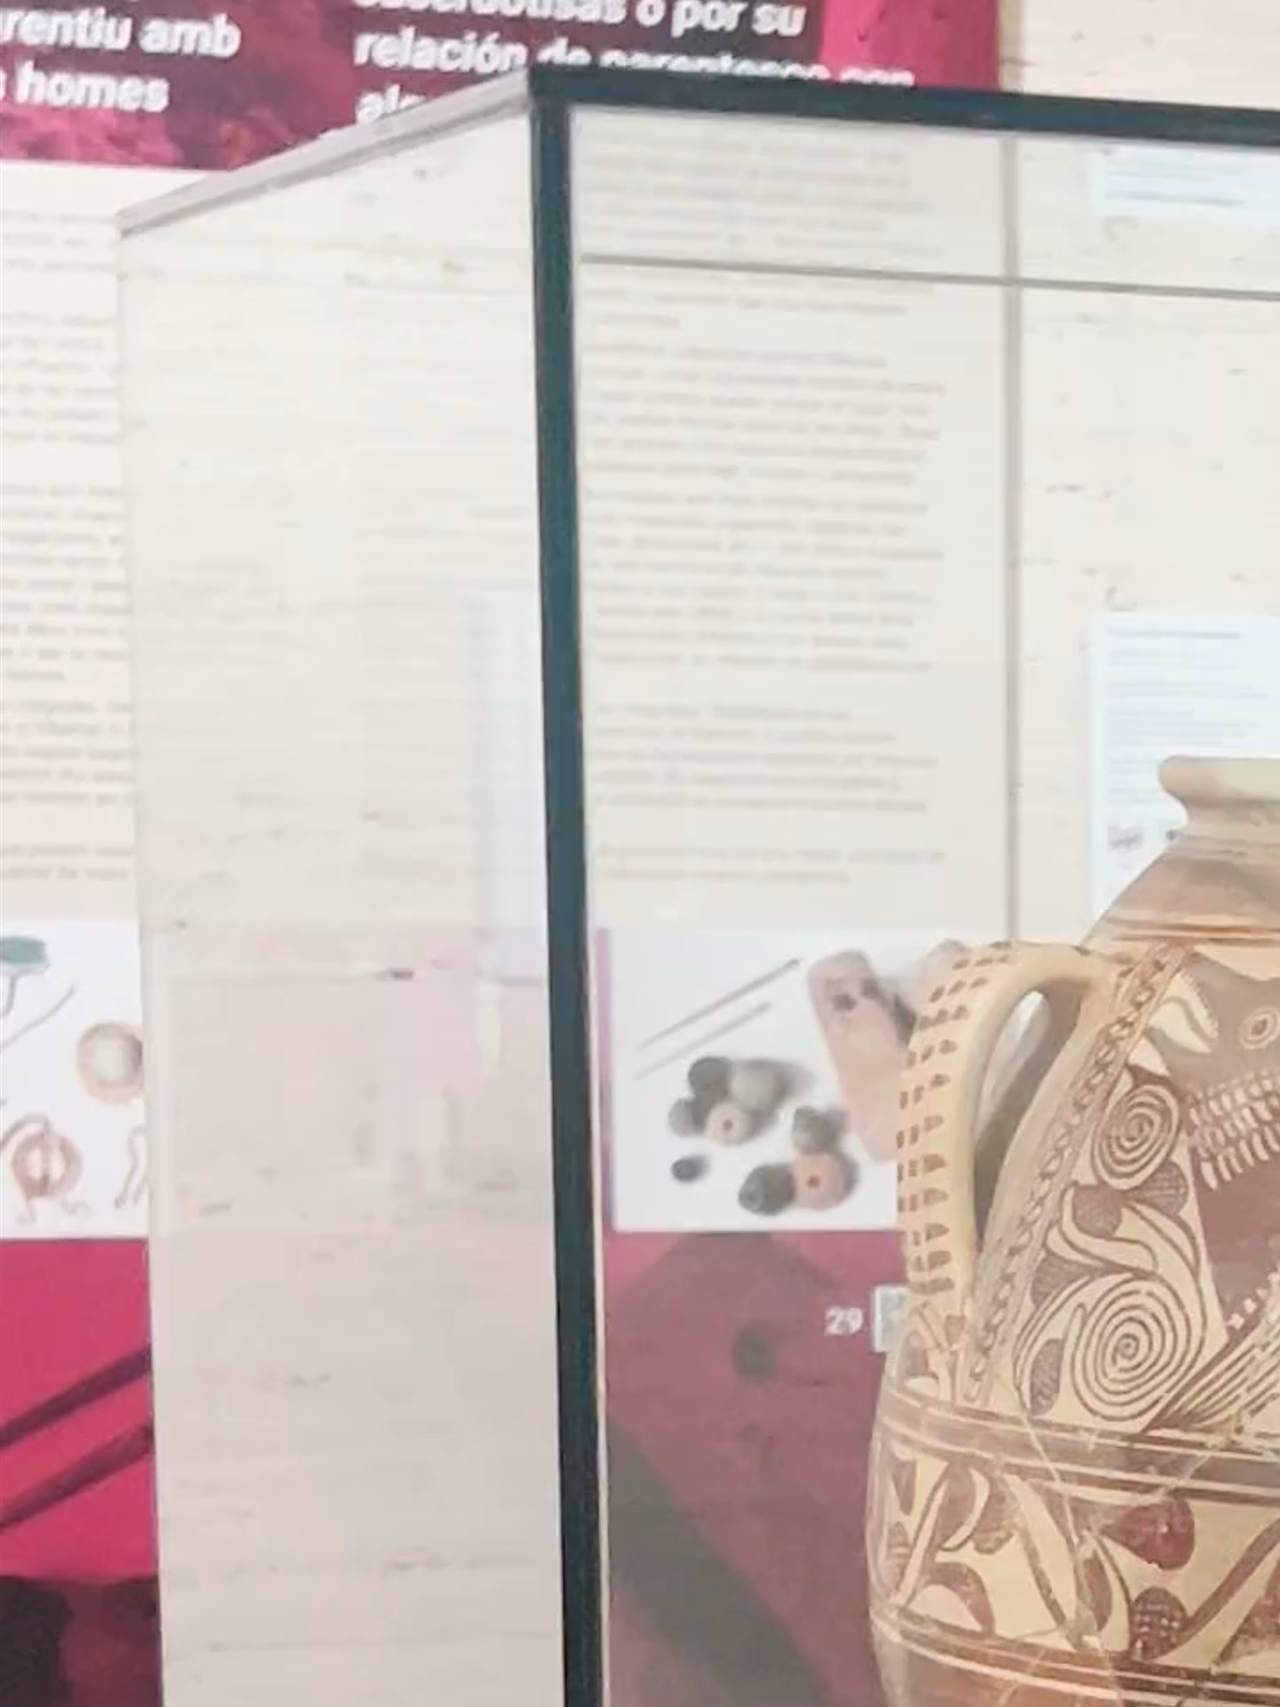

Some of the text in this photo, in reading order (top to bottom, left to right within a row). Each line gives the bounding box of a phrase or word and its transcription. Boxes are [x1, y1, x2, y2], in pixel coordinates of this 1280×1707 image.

[138, 11, 242, 58] amb
[751, 3, 807, 38] su
[352, 24, 530, 74] relación
[15, 59, 170, 113] homes
